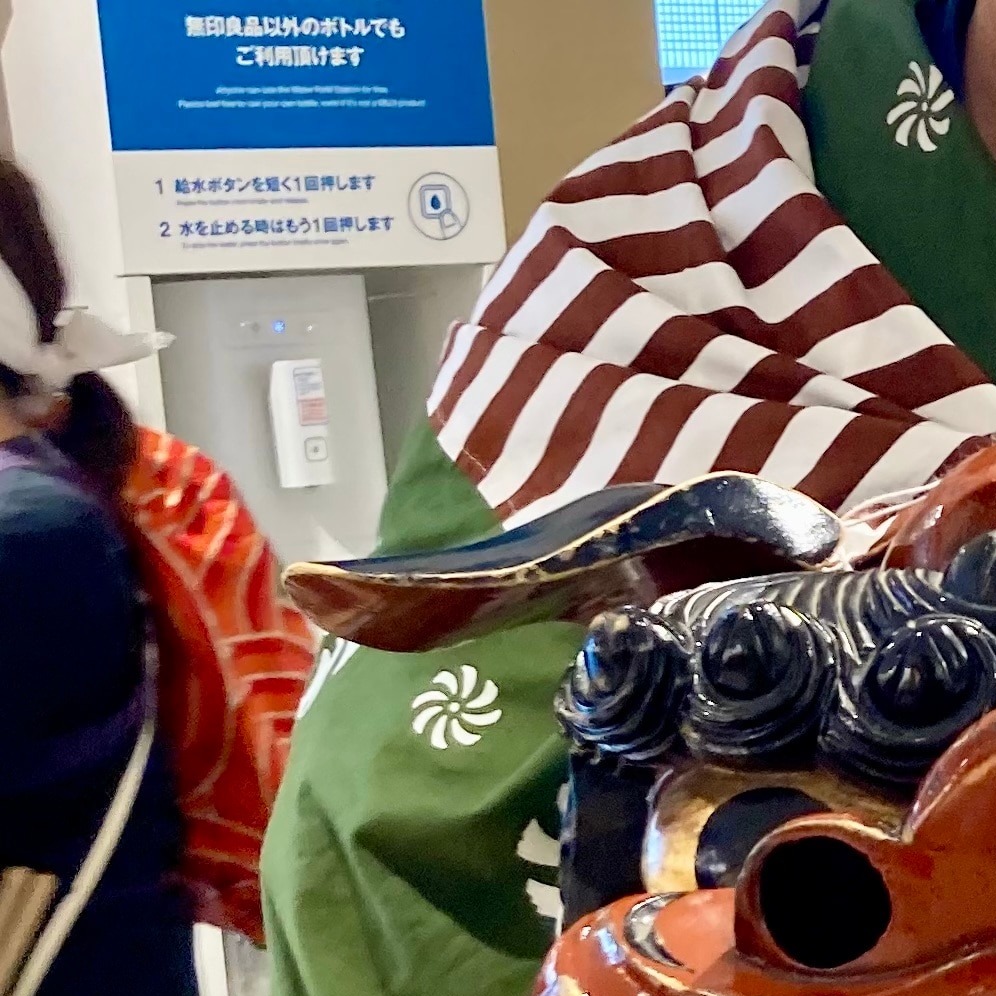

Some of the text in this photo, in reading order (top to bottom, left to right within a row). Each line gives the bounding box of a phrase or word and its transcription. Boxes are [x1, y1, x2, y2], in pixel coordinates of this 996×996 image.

[185, 15, 406, 38] 無印良品以外のボトルでも
[236, 45, 365, 67] ご利用頂けます
[155, 175, 376, 195] 1 給水ボタンを短く1回押します
[159, 216, 395, 238] 2 水を止める時はもう1回押します
